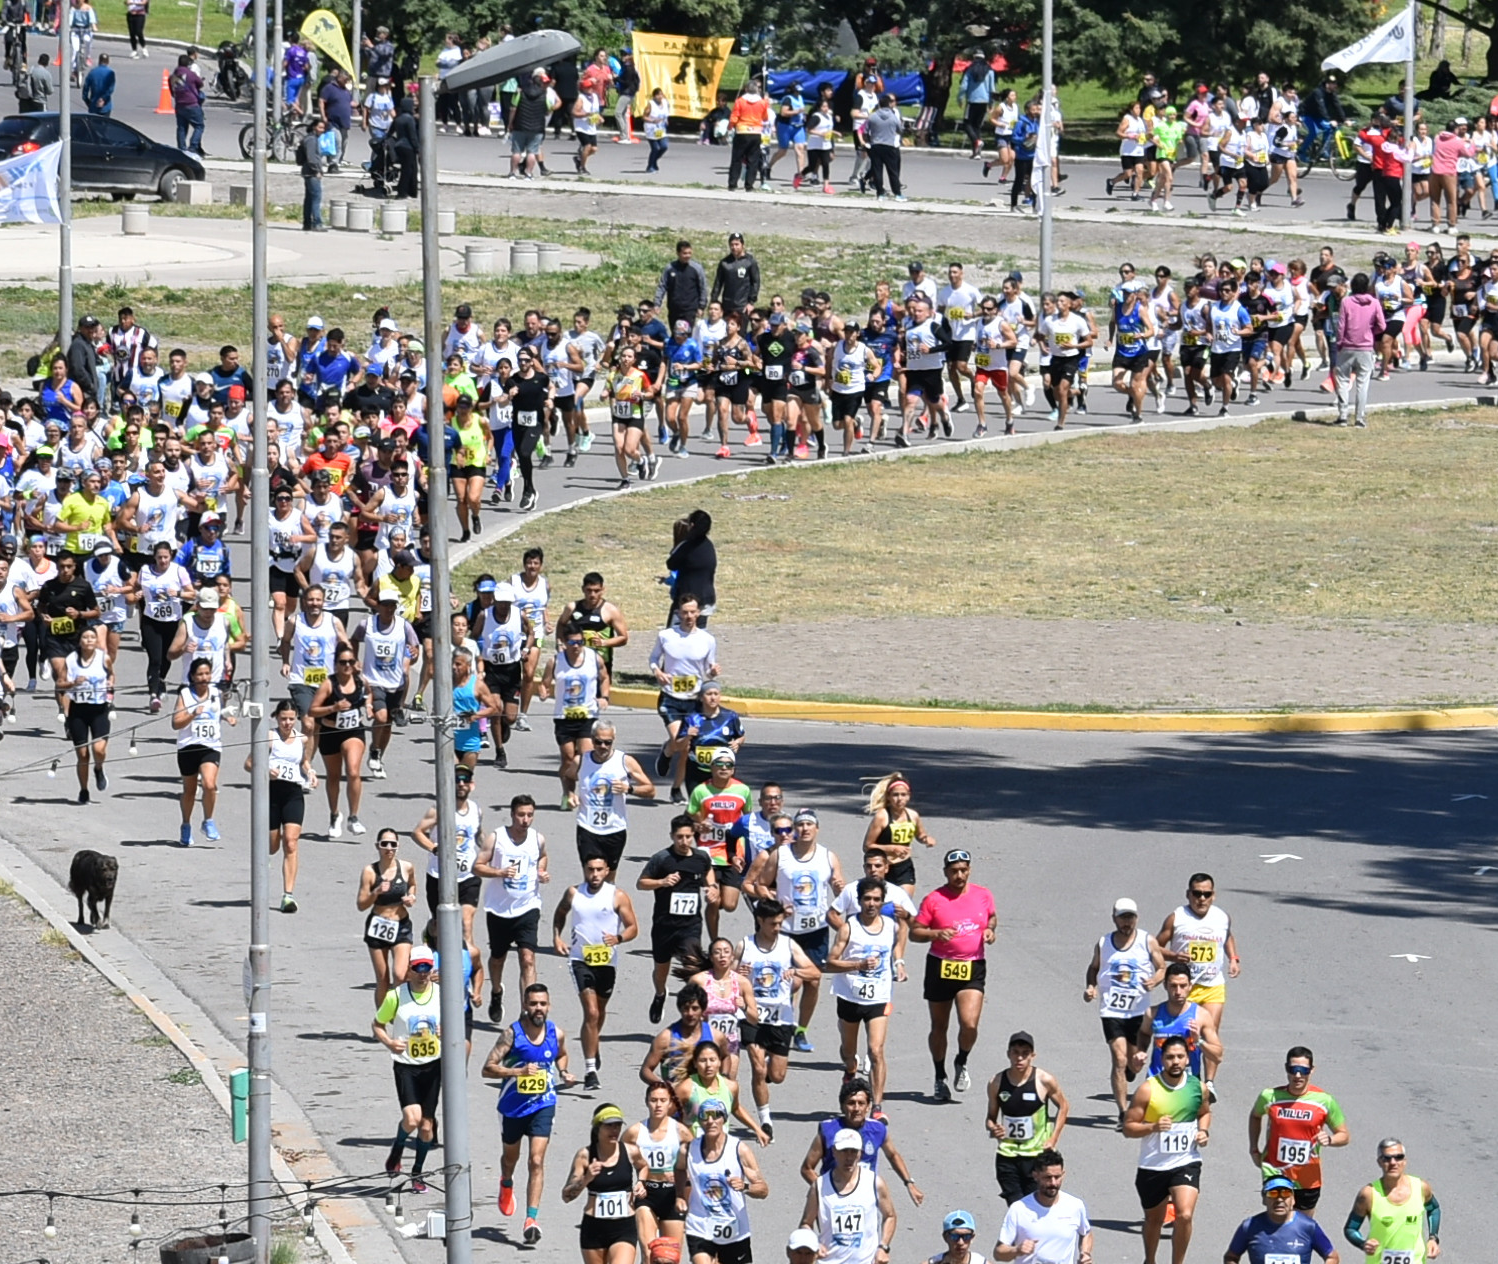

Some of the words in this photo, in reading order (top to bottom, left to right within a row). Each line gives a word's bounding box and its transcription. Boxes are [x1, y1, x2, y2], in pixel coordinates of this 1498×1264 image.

[154, 607, 172, 618] 269
[53, 620, 73, 632] 649
[376, 644, 391, 655] 56
[492, 652, 506, 663] 30
[195, 725, 215, 738] 150
[698, 750, 712, 763] 60
[593, 811, 608, 825] 29
[673, 900, 696, 914] 172
[372, 921, 395, 939] 126
[801, 917, 816, 928] 58
[584, 950, 610, 965] 433
[1191, 947, 1213, 961] 573
[944, 962, 969, 979] 549
[859, 983, 875, 998] 43
[1110, 993, 1136, 1010] 257
[410, 1038, 436, 1058] 635
[519, 1077, 546, 1093] 429
[1278, 1108, 1312, 1119] MILLA
[1008, 1122, 1026, 1139] 25
[1163, 1134, 1190, 1152] 119
[648, 1150, 665, 1168] 19
[1279, 1144, 1306, 1164] 195
[598, 1198, 623, 1216] 101
[835, 1213, 862, 1231] 147
[713, 1225, 732, 1239] 50
